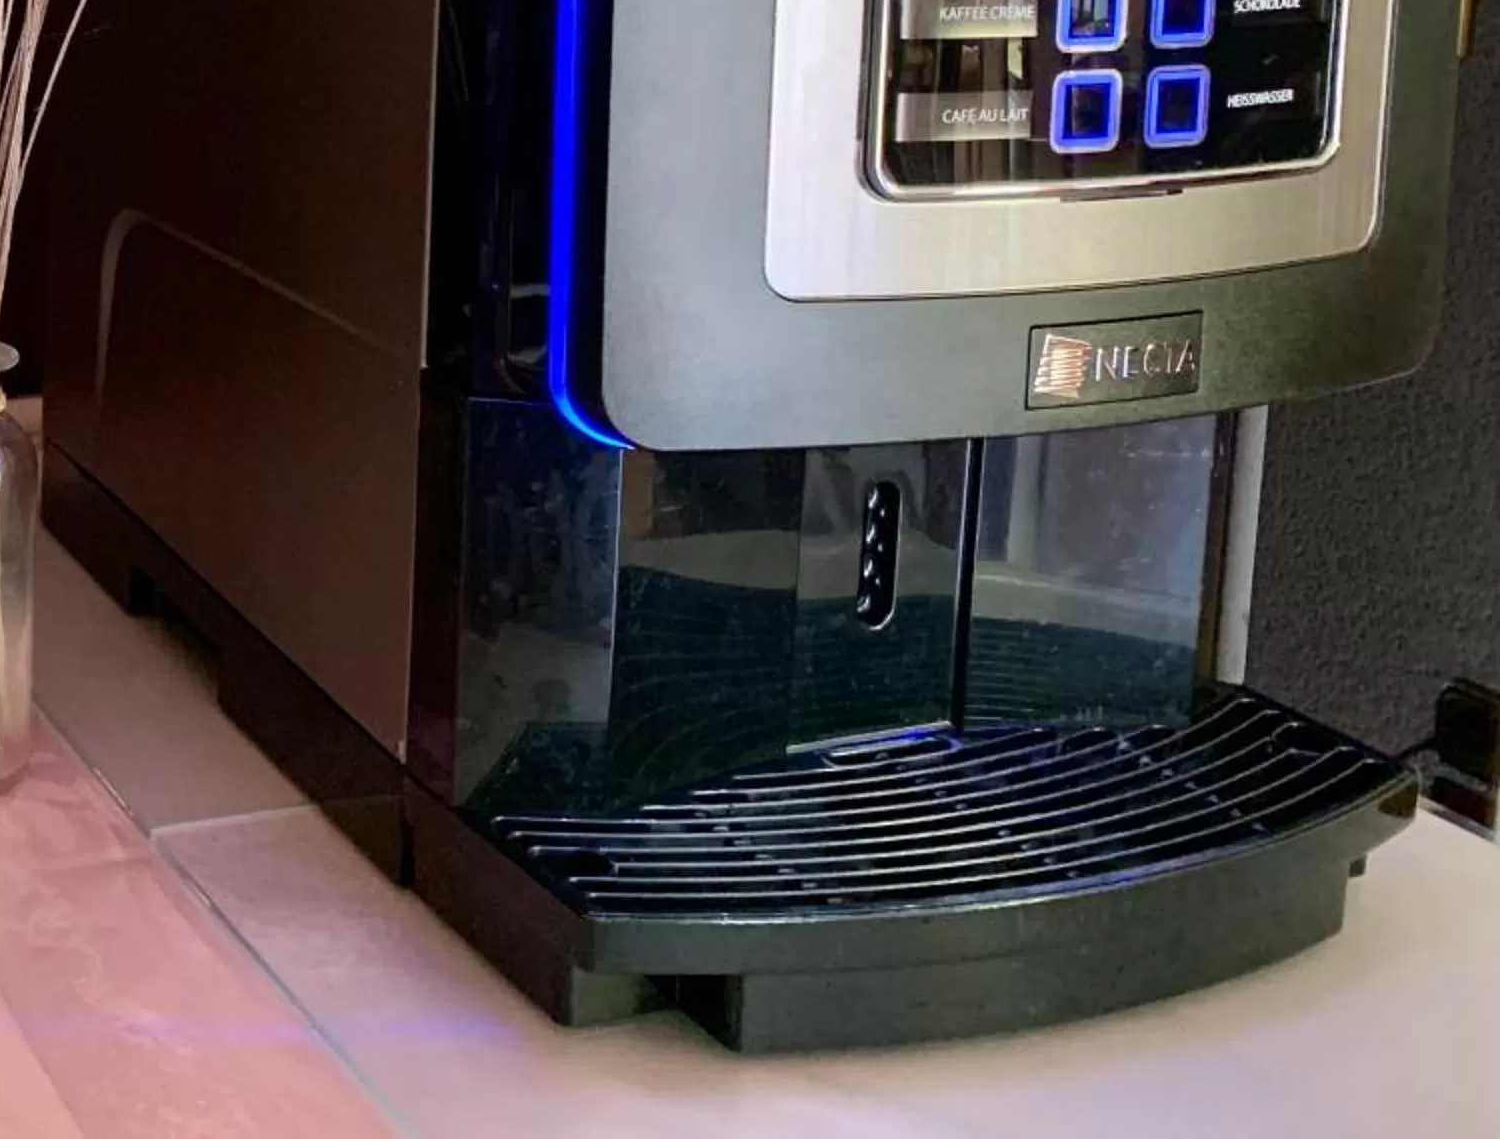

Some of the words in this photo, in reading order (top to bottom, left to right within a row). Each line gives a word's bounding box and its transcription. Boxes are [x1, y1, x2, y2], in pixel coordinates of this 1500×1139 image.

[938, 5, 989, 22] KAFFEE
[978, 108, 998, 122] AU
[999, 108, 1030, 122] LAIT
